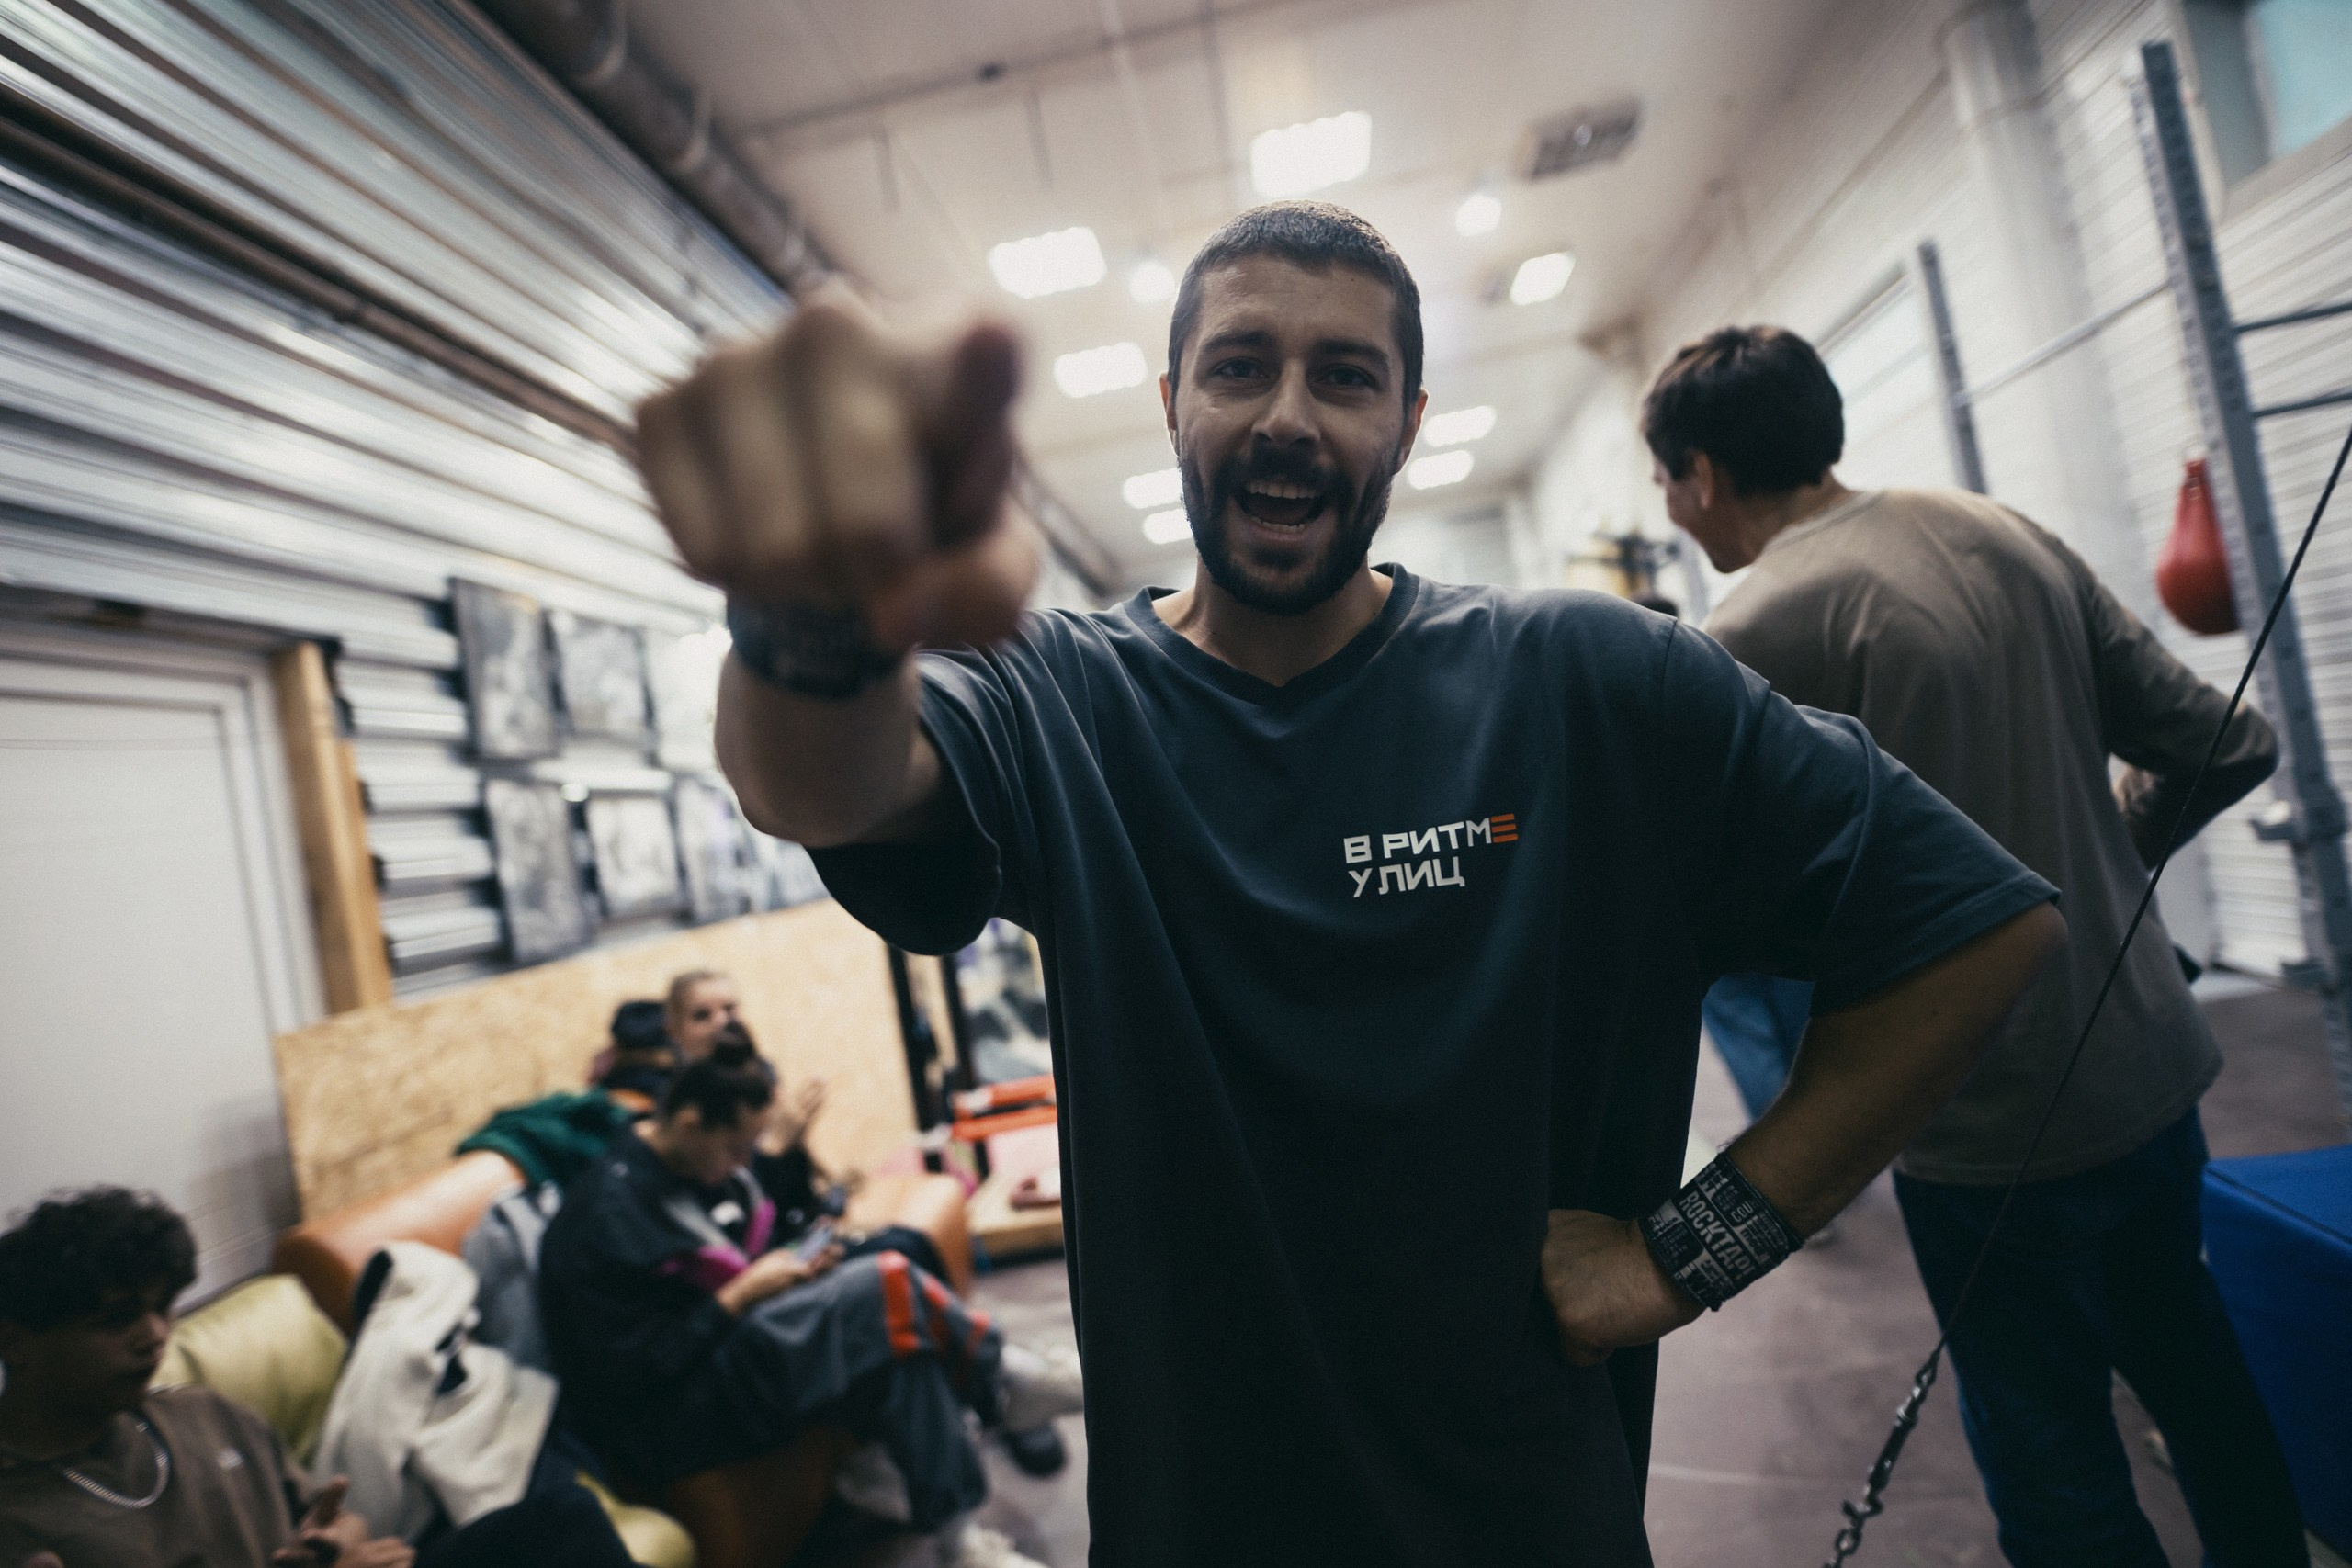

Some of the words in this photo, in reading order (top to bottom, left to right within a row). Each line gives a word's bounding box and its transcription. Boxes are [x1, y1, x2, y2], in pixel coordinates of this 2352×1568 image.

[1343, 835, 1373, 863] В
[1382, 813, 1519, 859] РИТМЕ
[1348, 856, 1465, 898] УЛИЦ
